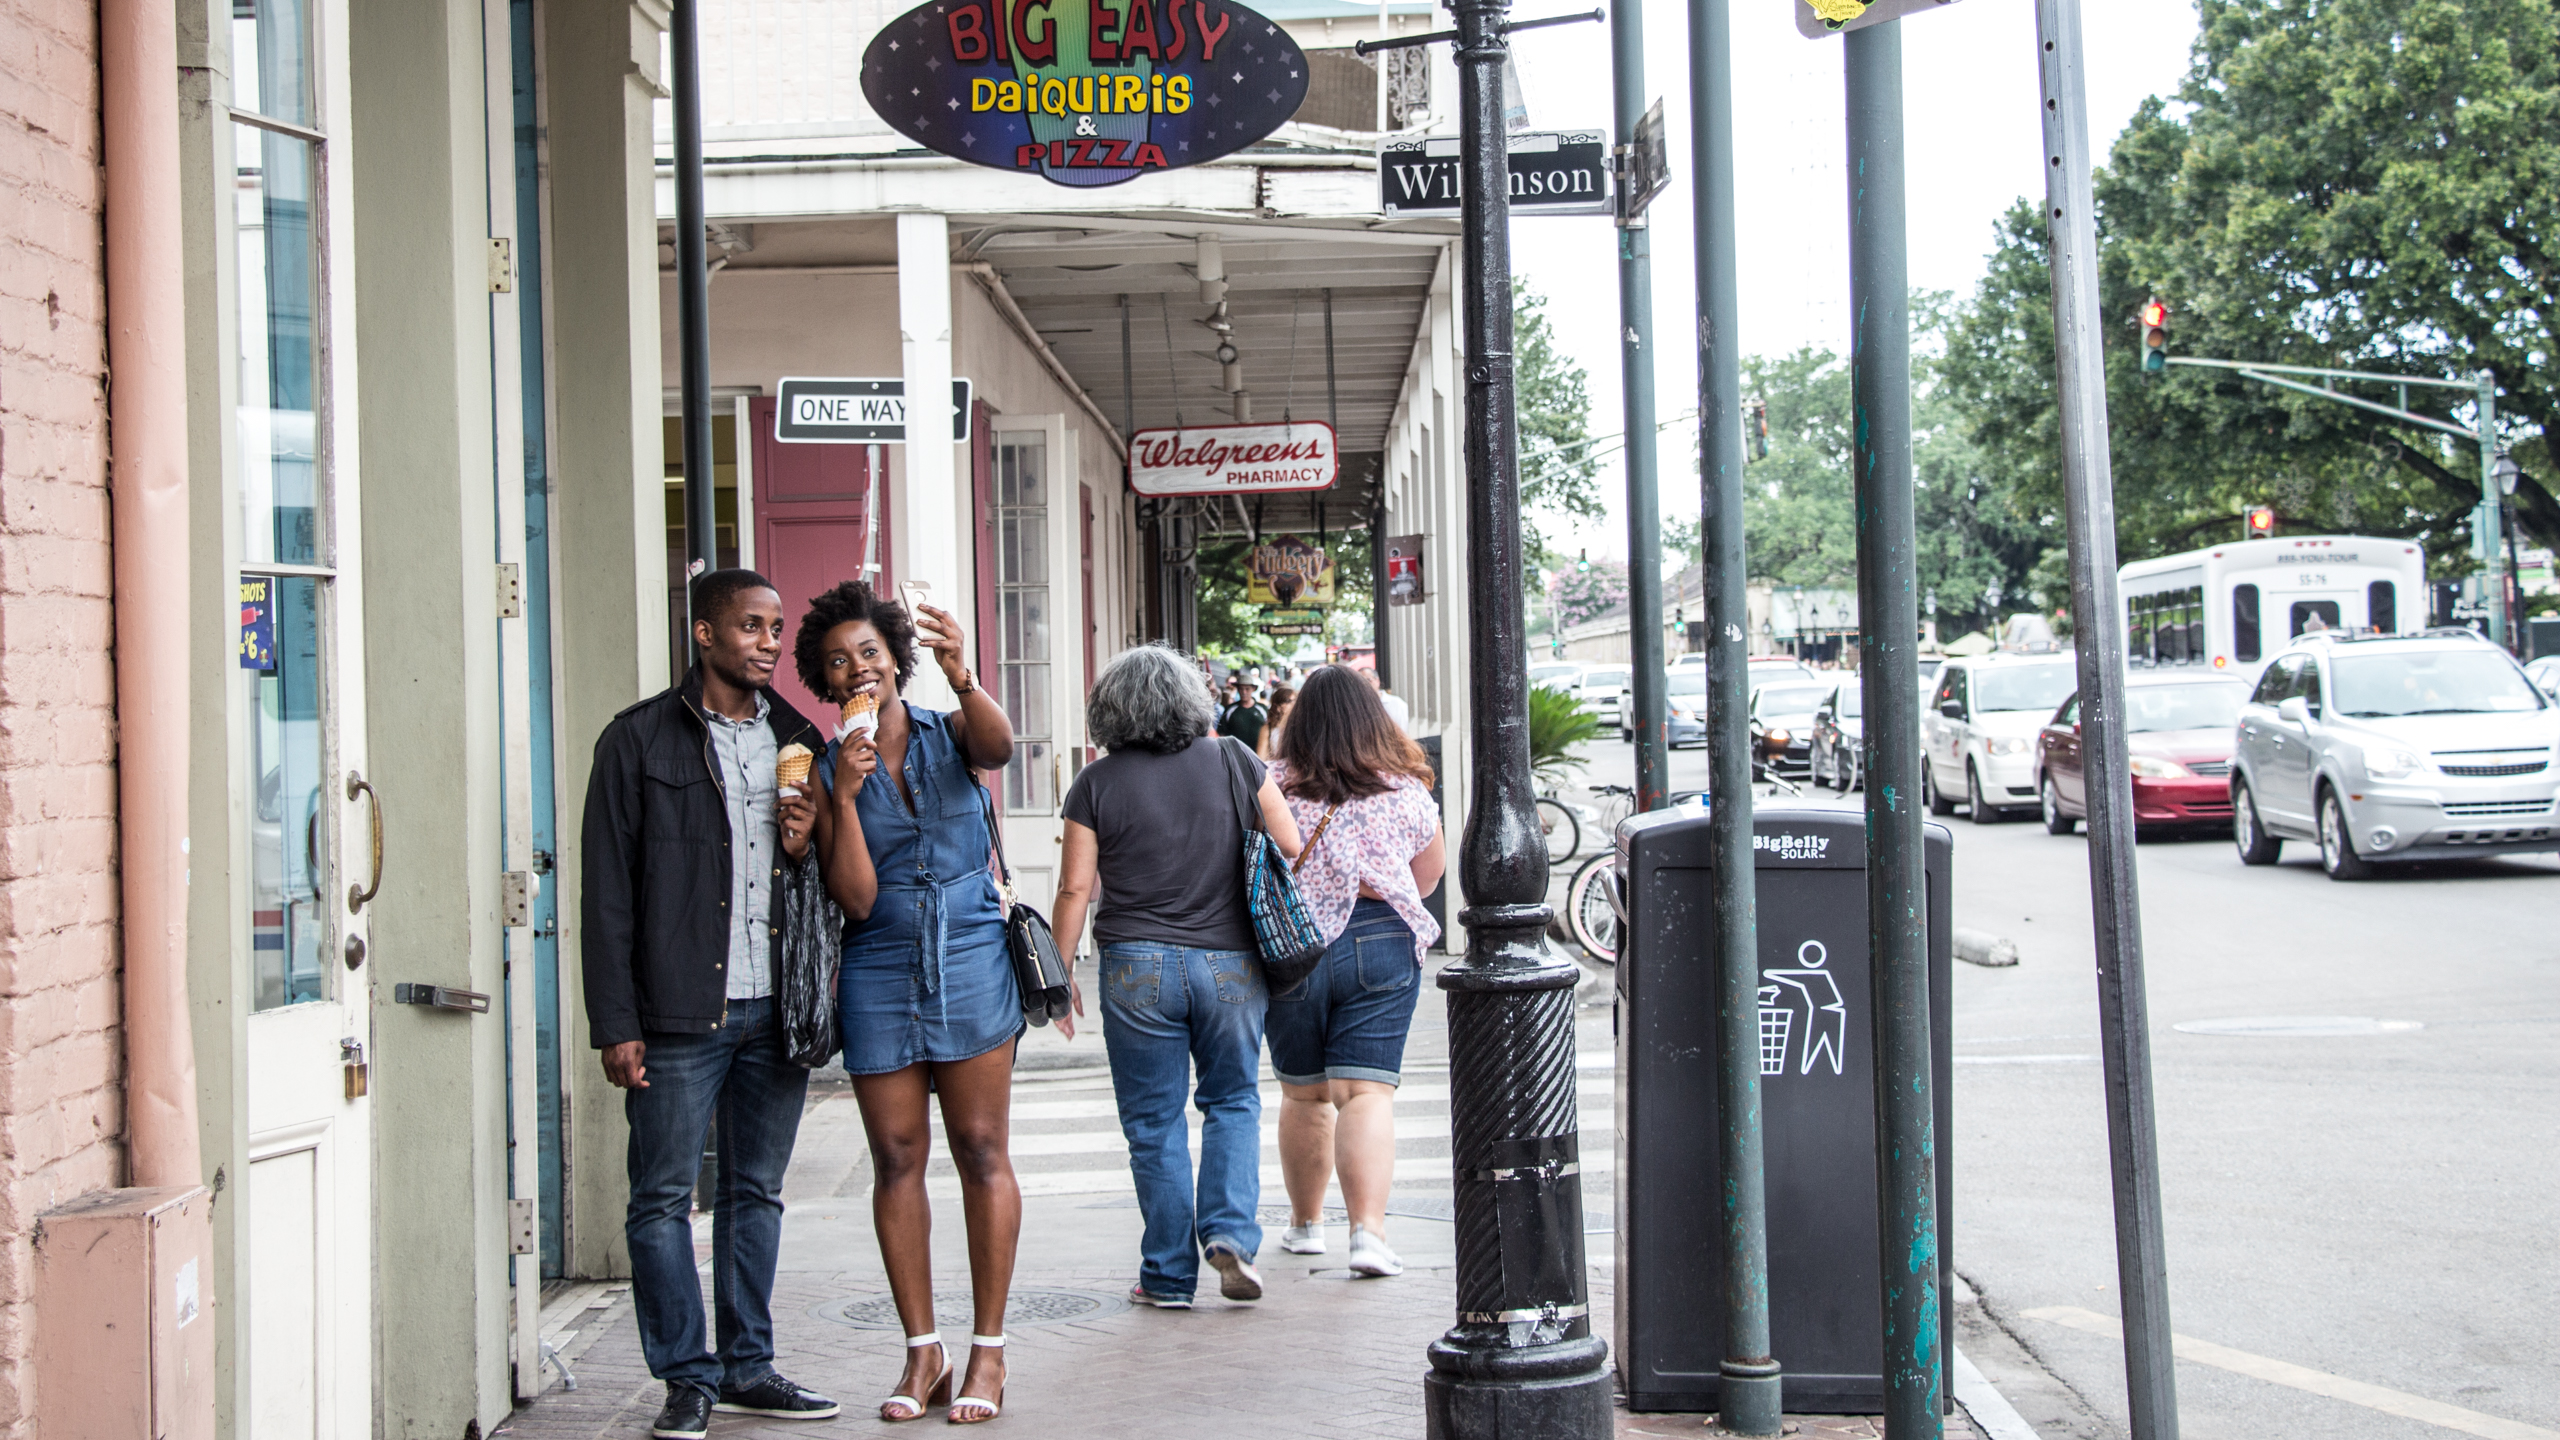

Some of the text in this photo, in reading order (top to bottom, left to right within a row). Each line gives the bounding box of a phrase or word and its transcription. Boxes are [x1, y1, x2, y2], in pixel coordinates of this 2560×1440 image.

[948, 0, 1230, 61] BIG EASY
[1075, 115, 1099, 137] &
[1016, 139, 1169, 168] PIZZA
[1392, 162, 1594, 200] Wilnson
[800, 399, 850, 421] ONE
[1136, 435, 1326, 477] Walgreens
[1226, 468, 1324, 485] PHARMACY
[1253, 546, 1324, 582] Fudgery
[244, 630, 258, 660] $6
[1753, 835, 1829, 852] BigBelly
[1781, 849, 1819, 860] SOLAR
